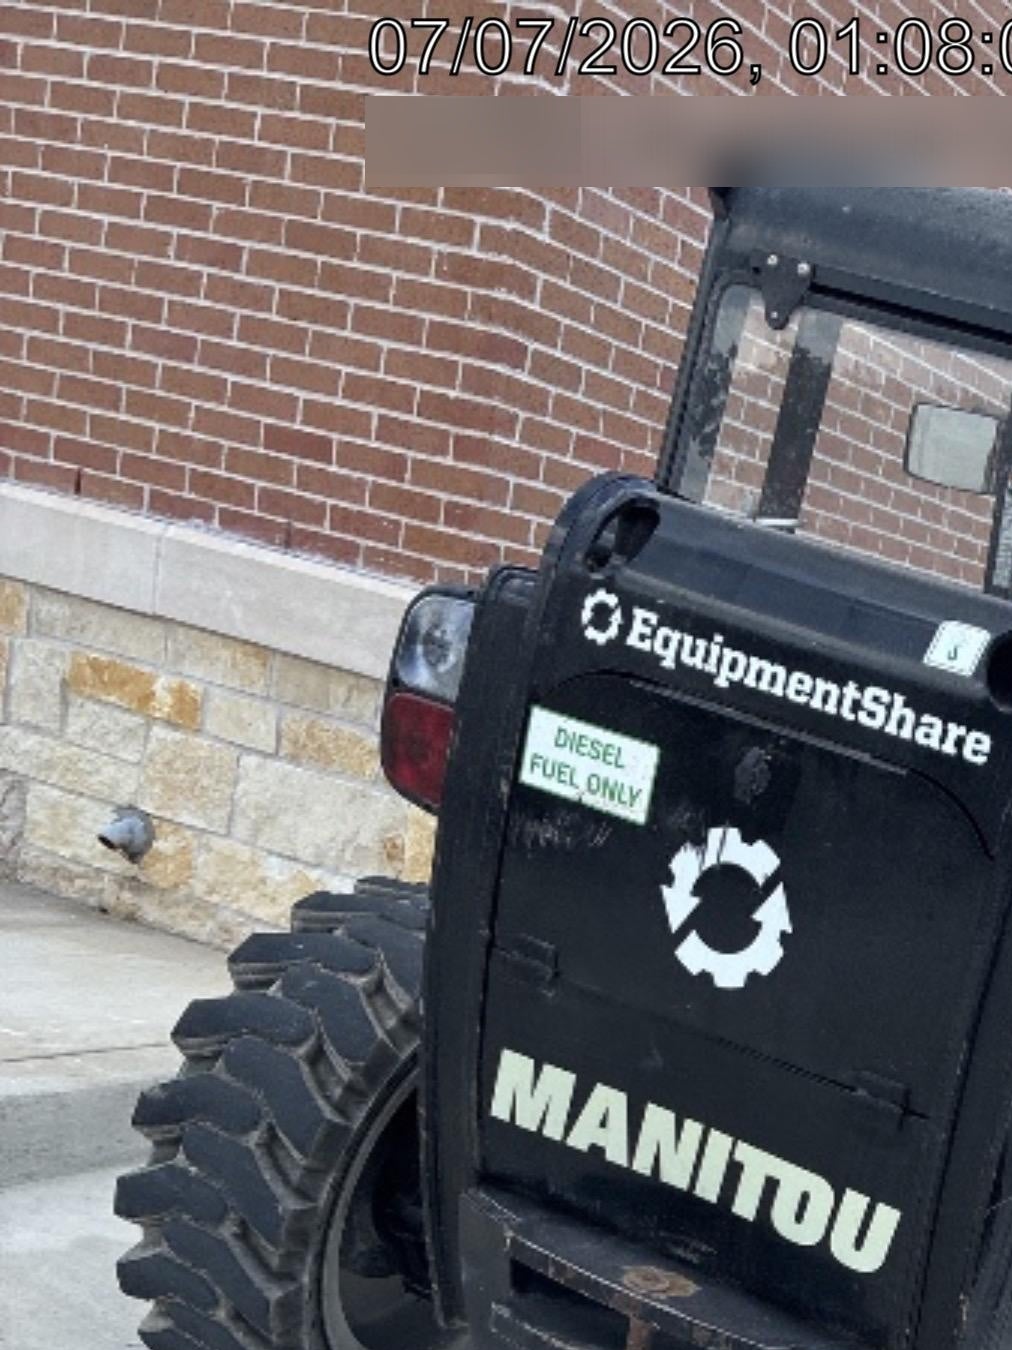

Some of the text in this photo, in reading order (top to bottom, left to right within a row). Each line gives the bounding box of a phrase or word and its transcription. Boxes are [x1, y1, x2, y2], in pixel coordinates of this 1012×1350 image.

[625, 607, 992, 765] EquipmentShare
[530, 753, 642, 807] FUEL ONLY
[554, 726, 625, 769] DIESEL
[491, 1048, 901, 1273] MANITOU
